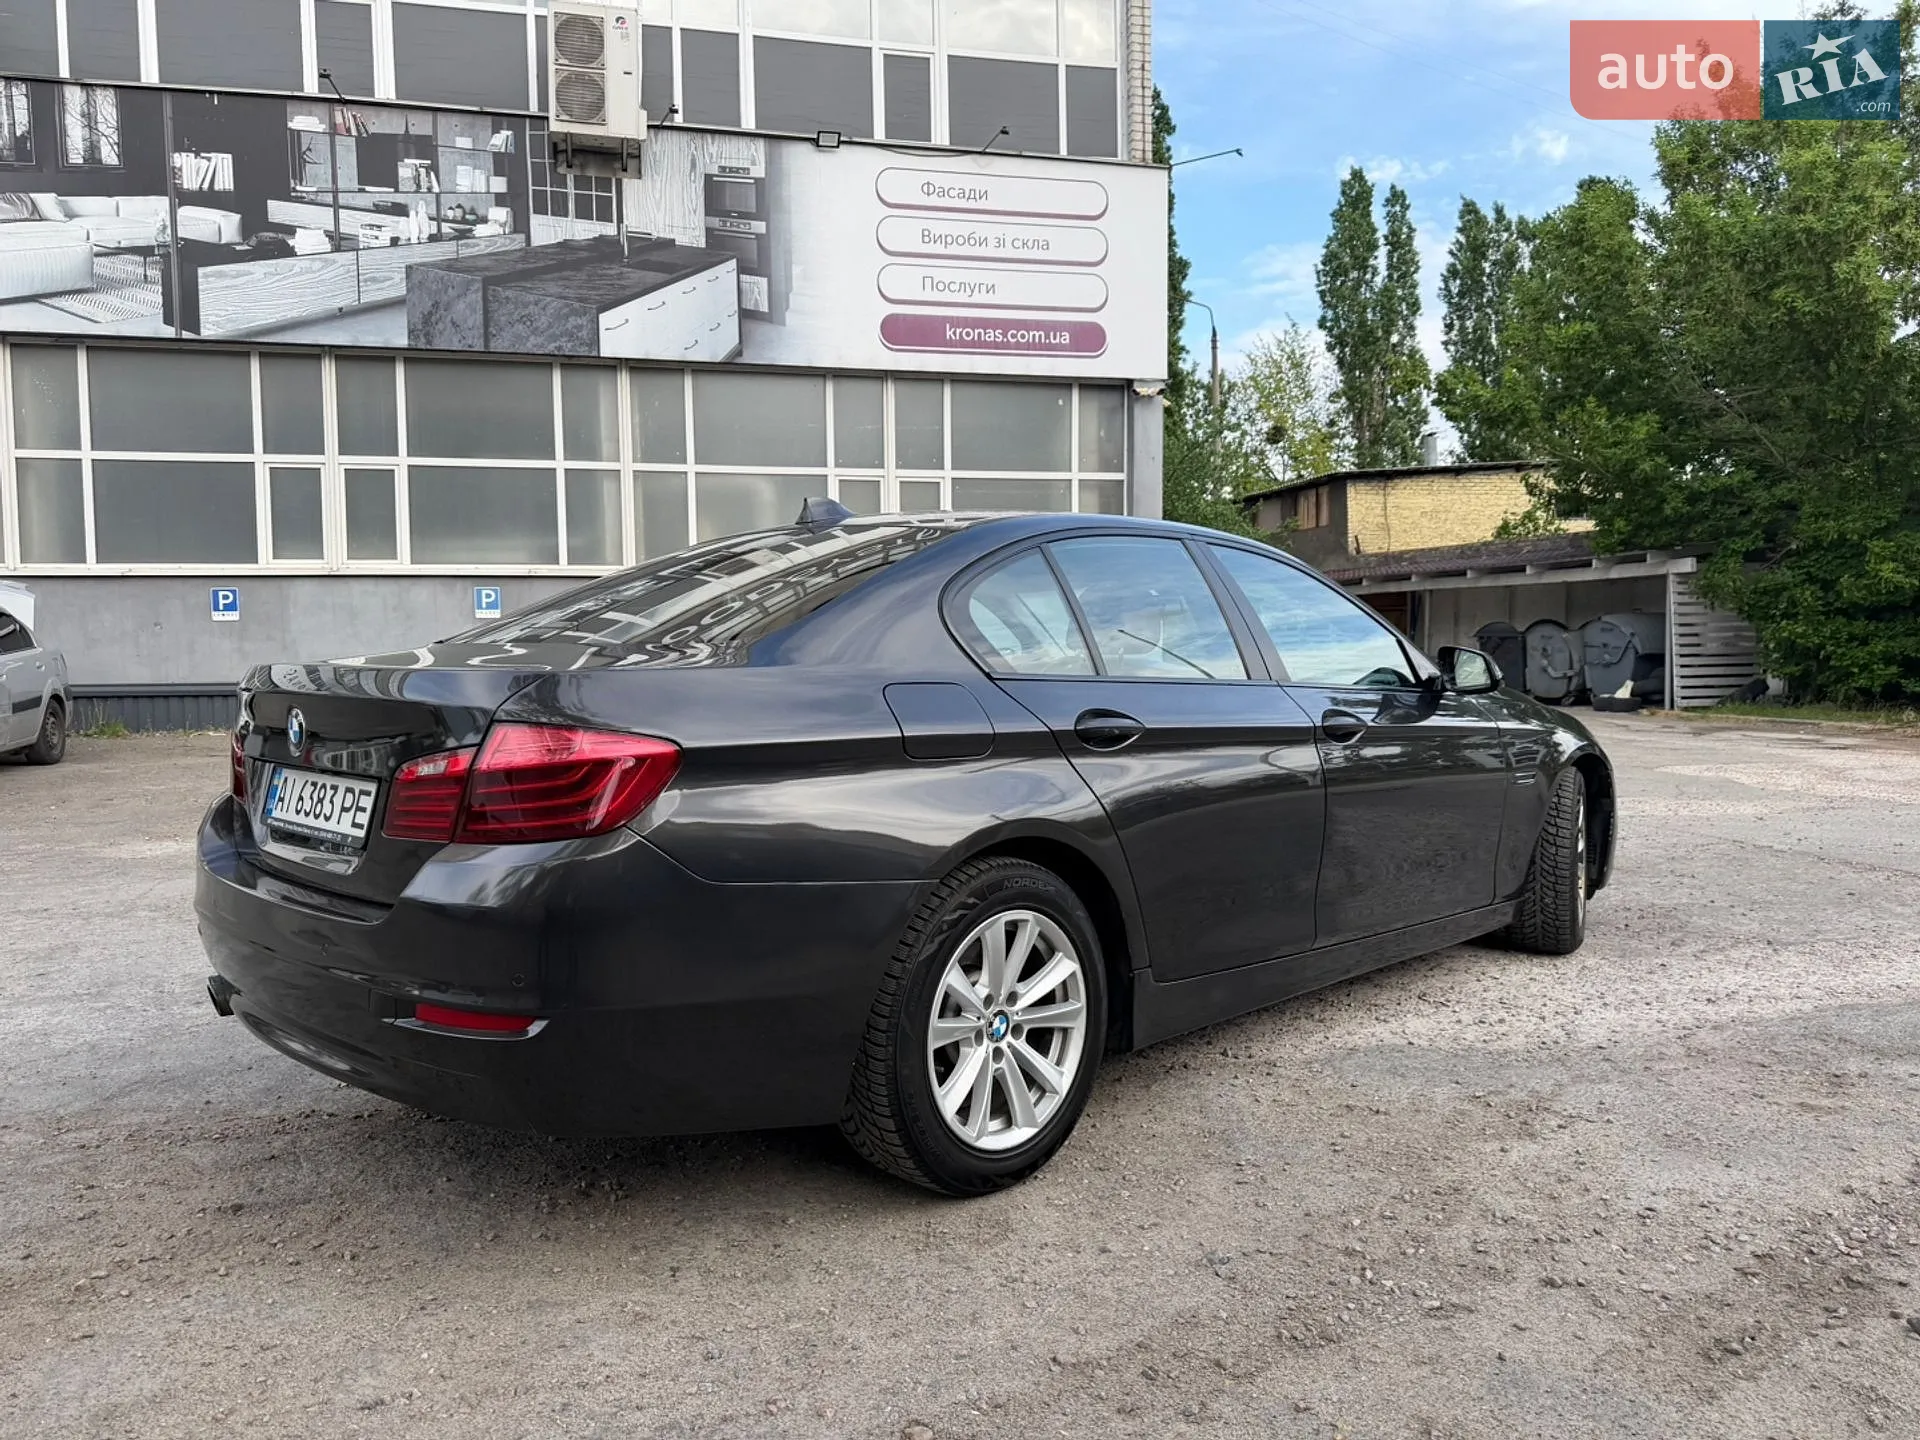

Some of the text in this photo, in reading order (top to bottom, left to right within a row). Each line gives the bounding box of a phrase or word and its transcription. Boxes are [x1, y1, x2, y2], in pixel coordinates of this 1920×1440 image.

[920, 180, 989, 202] Фасади
[920, 227, 1050, 251] Вироби зі скла
[921, 275, 996, 297] Послуги
[945, 323, 1070, 344] kronas.com.ua
[218, 590, 234, 611] P
[481, 589, 496, 609] P
[274, 776, 296, 814] AI
[295, 779, 340, 823] 6383
[337, 786, 372, 831] PE
